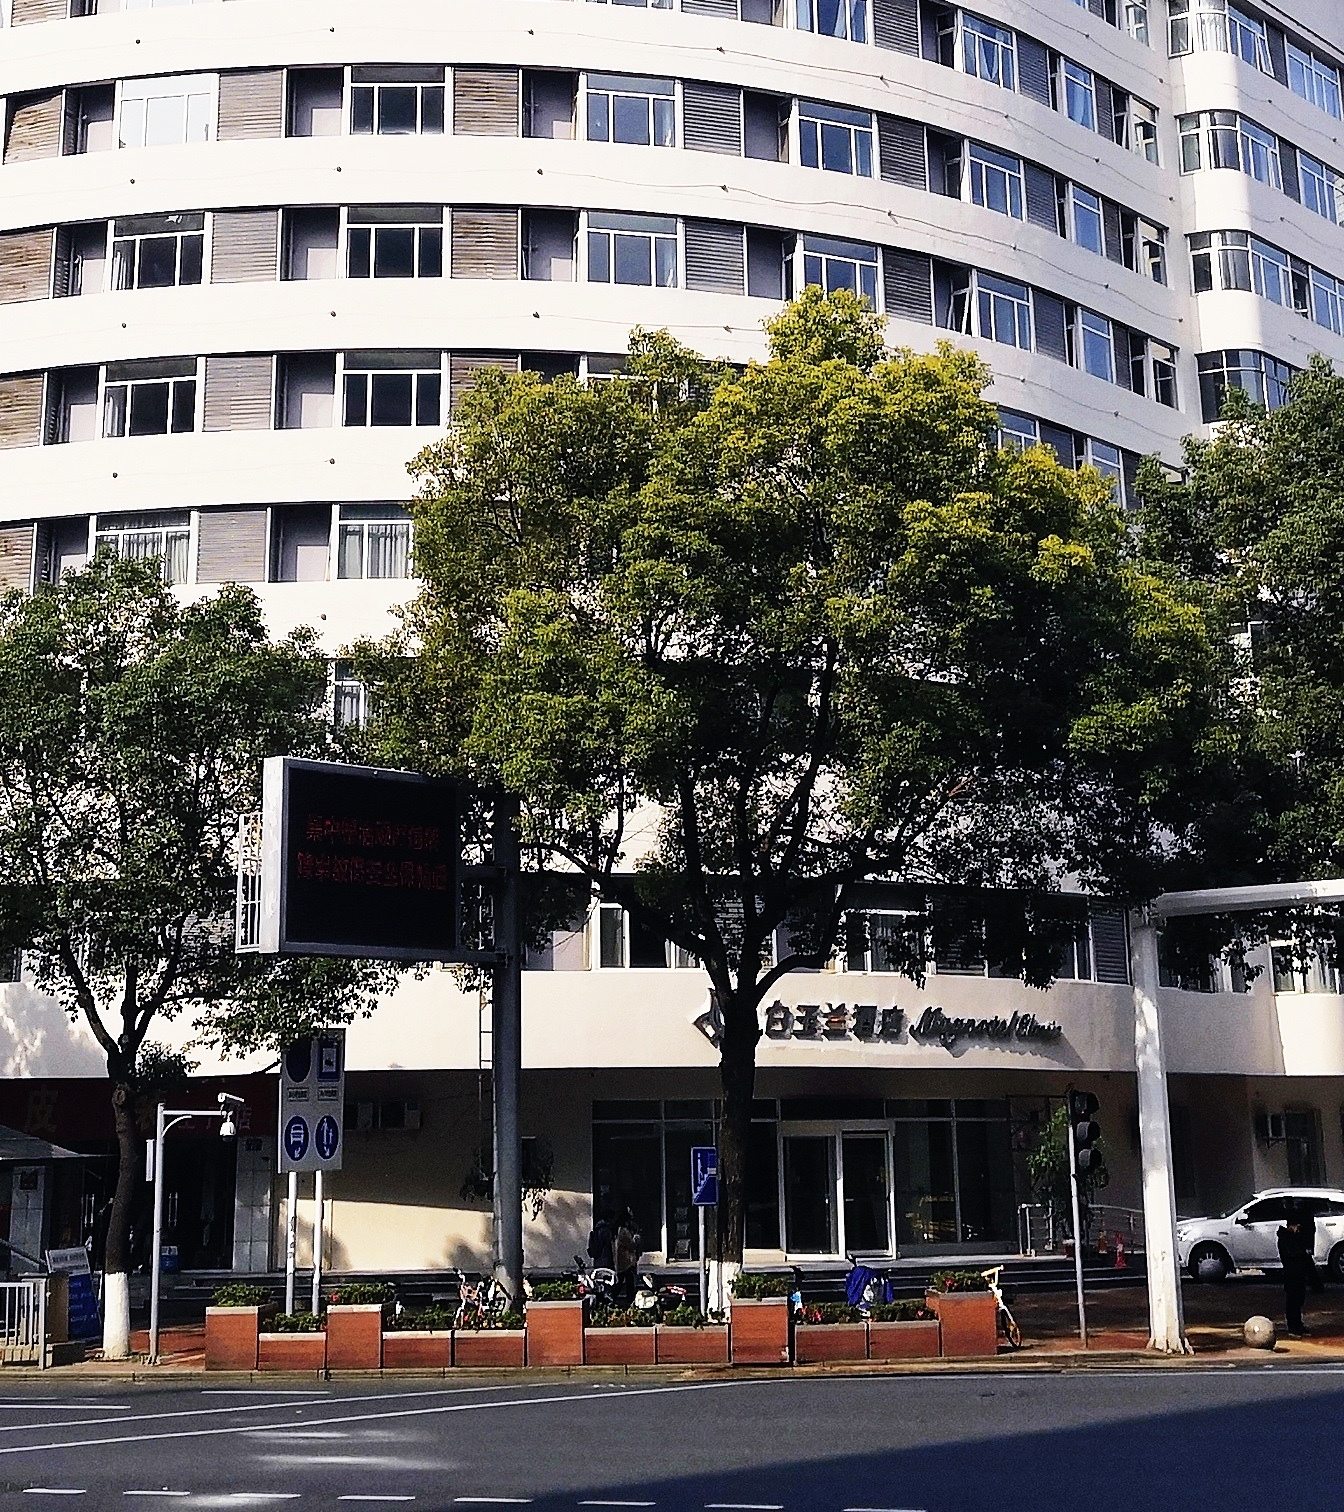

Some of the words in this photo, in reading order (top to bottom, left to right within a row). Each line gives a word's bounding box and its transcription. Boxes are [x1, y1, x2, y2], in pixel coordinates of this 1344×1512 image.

[765, 999, 908, 1044] 白玉兰酒店
